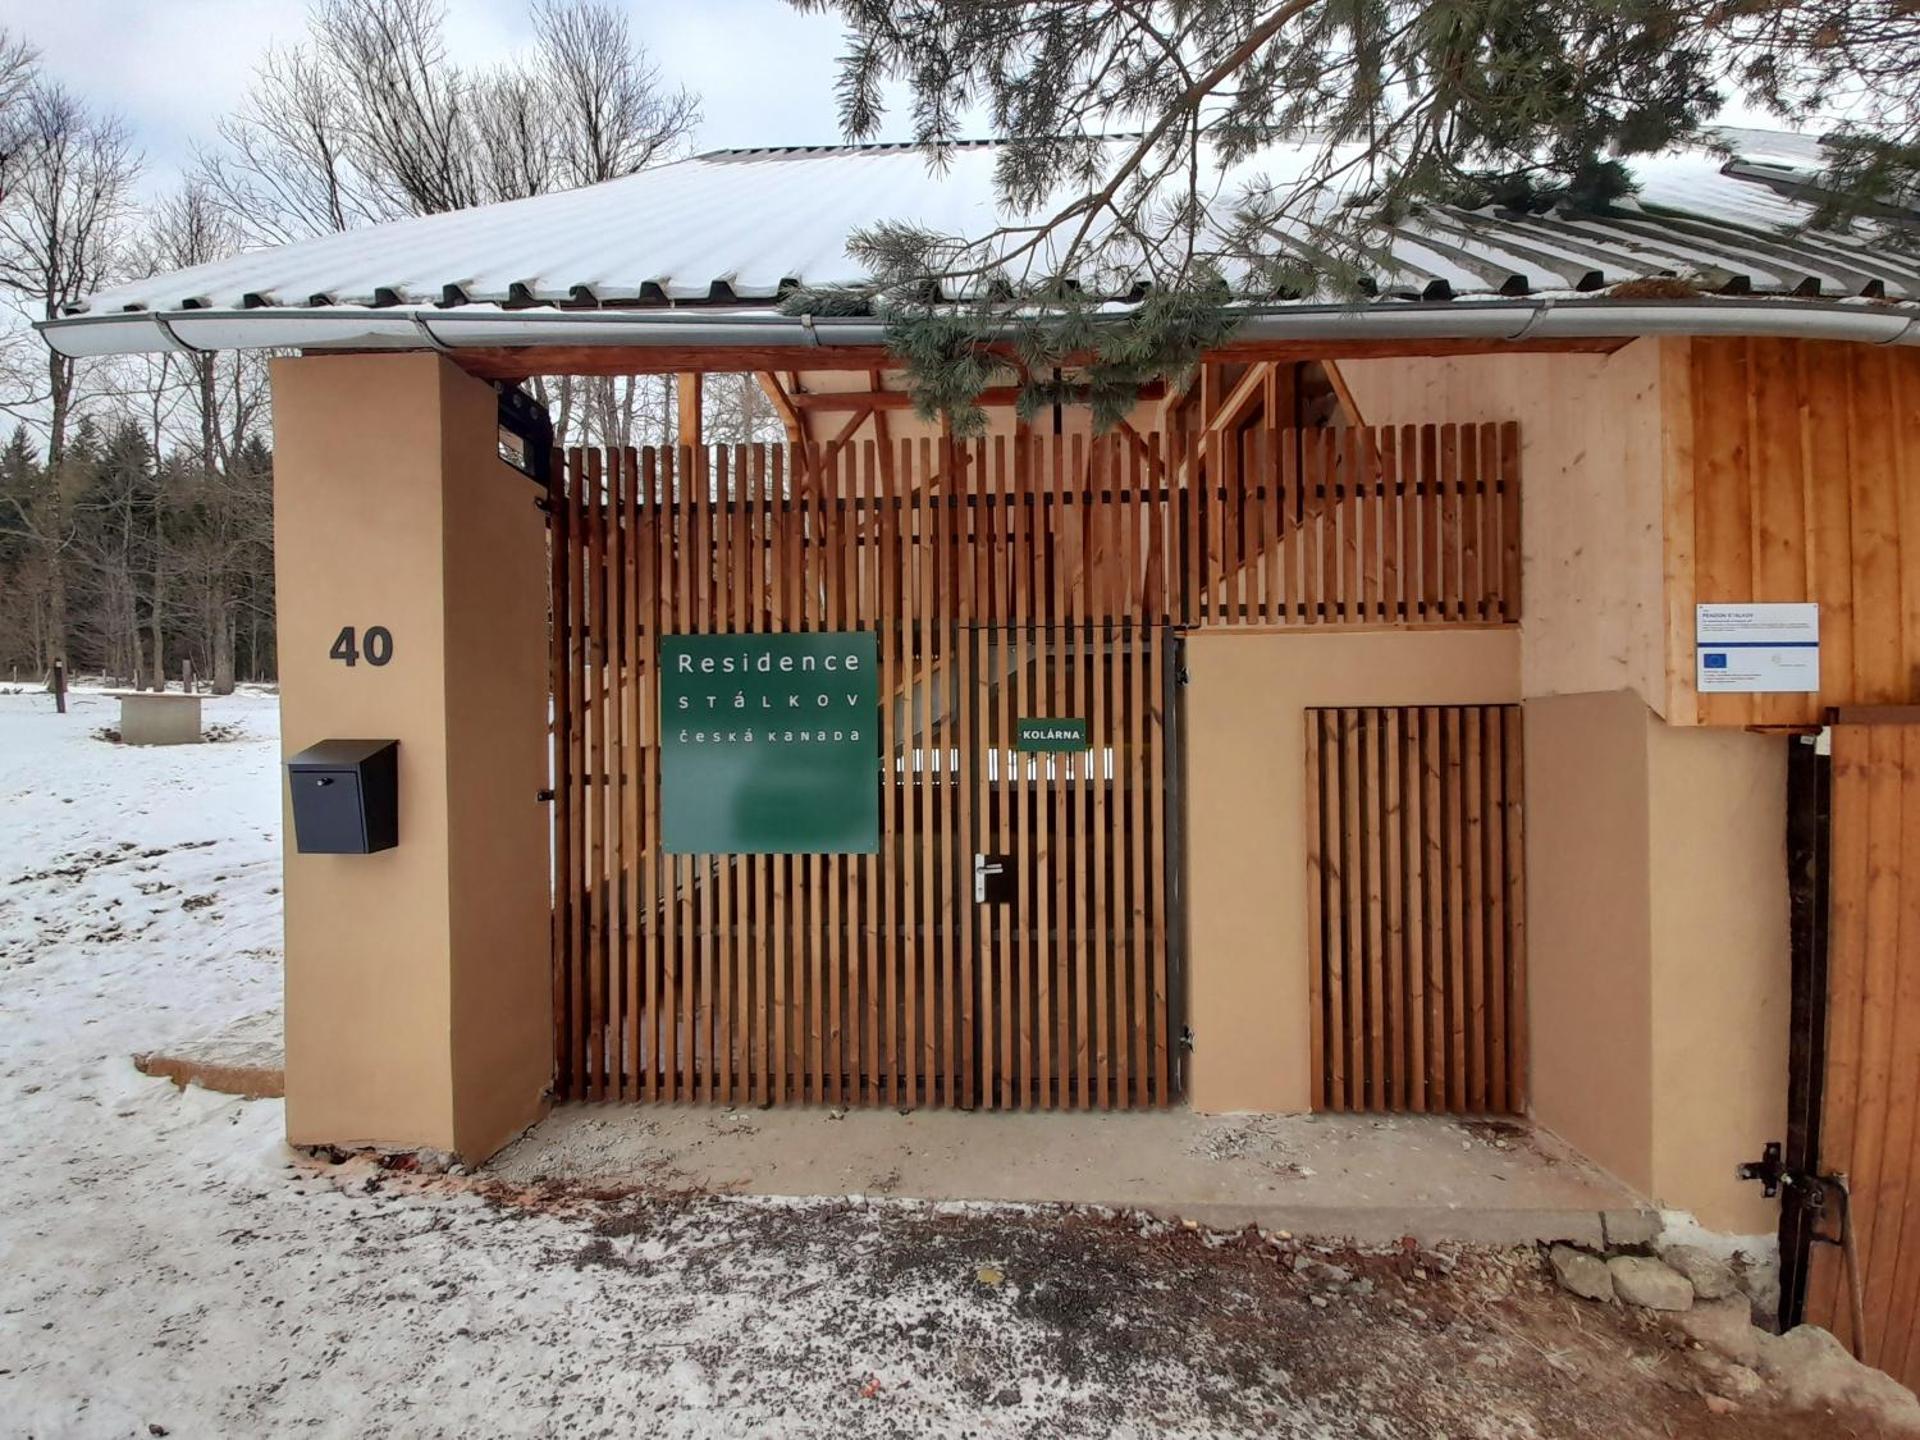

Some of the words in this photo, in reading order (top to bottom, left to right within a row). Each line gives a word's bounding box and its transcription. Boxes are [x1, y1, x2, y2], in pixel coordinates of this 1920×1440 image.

[329, 625, 394, 667] 40
[678, 652, 859, 673] Residence
[1023, 728, 1080, 740] KOLÁRNA
